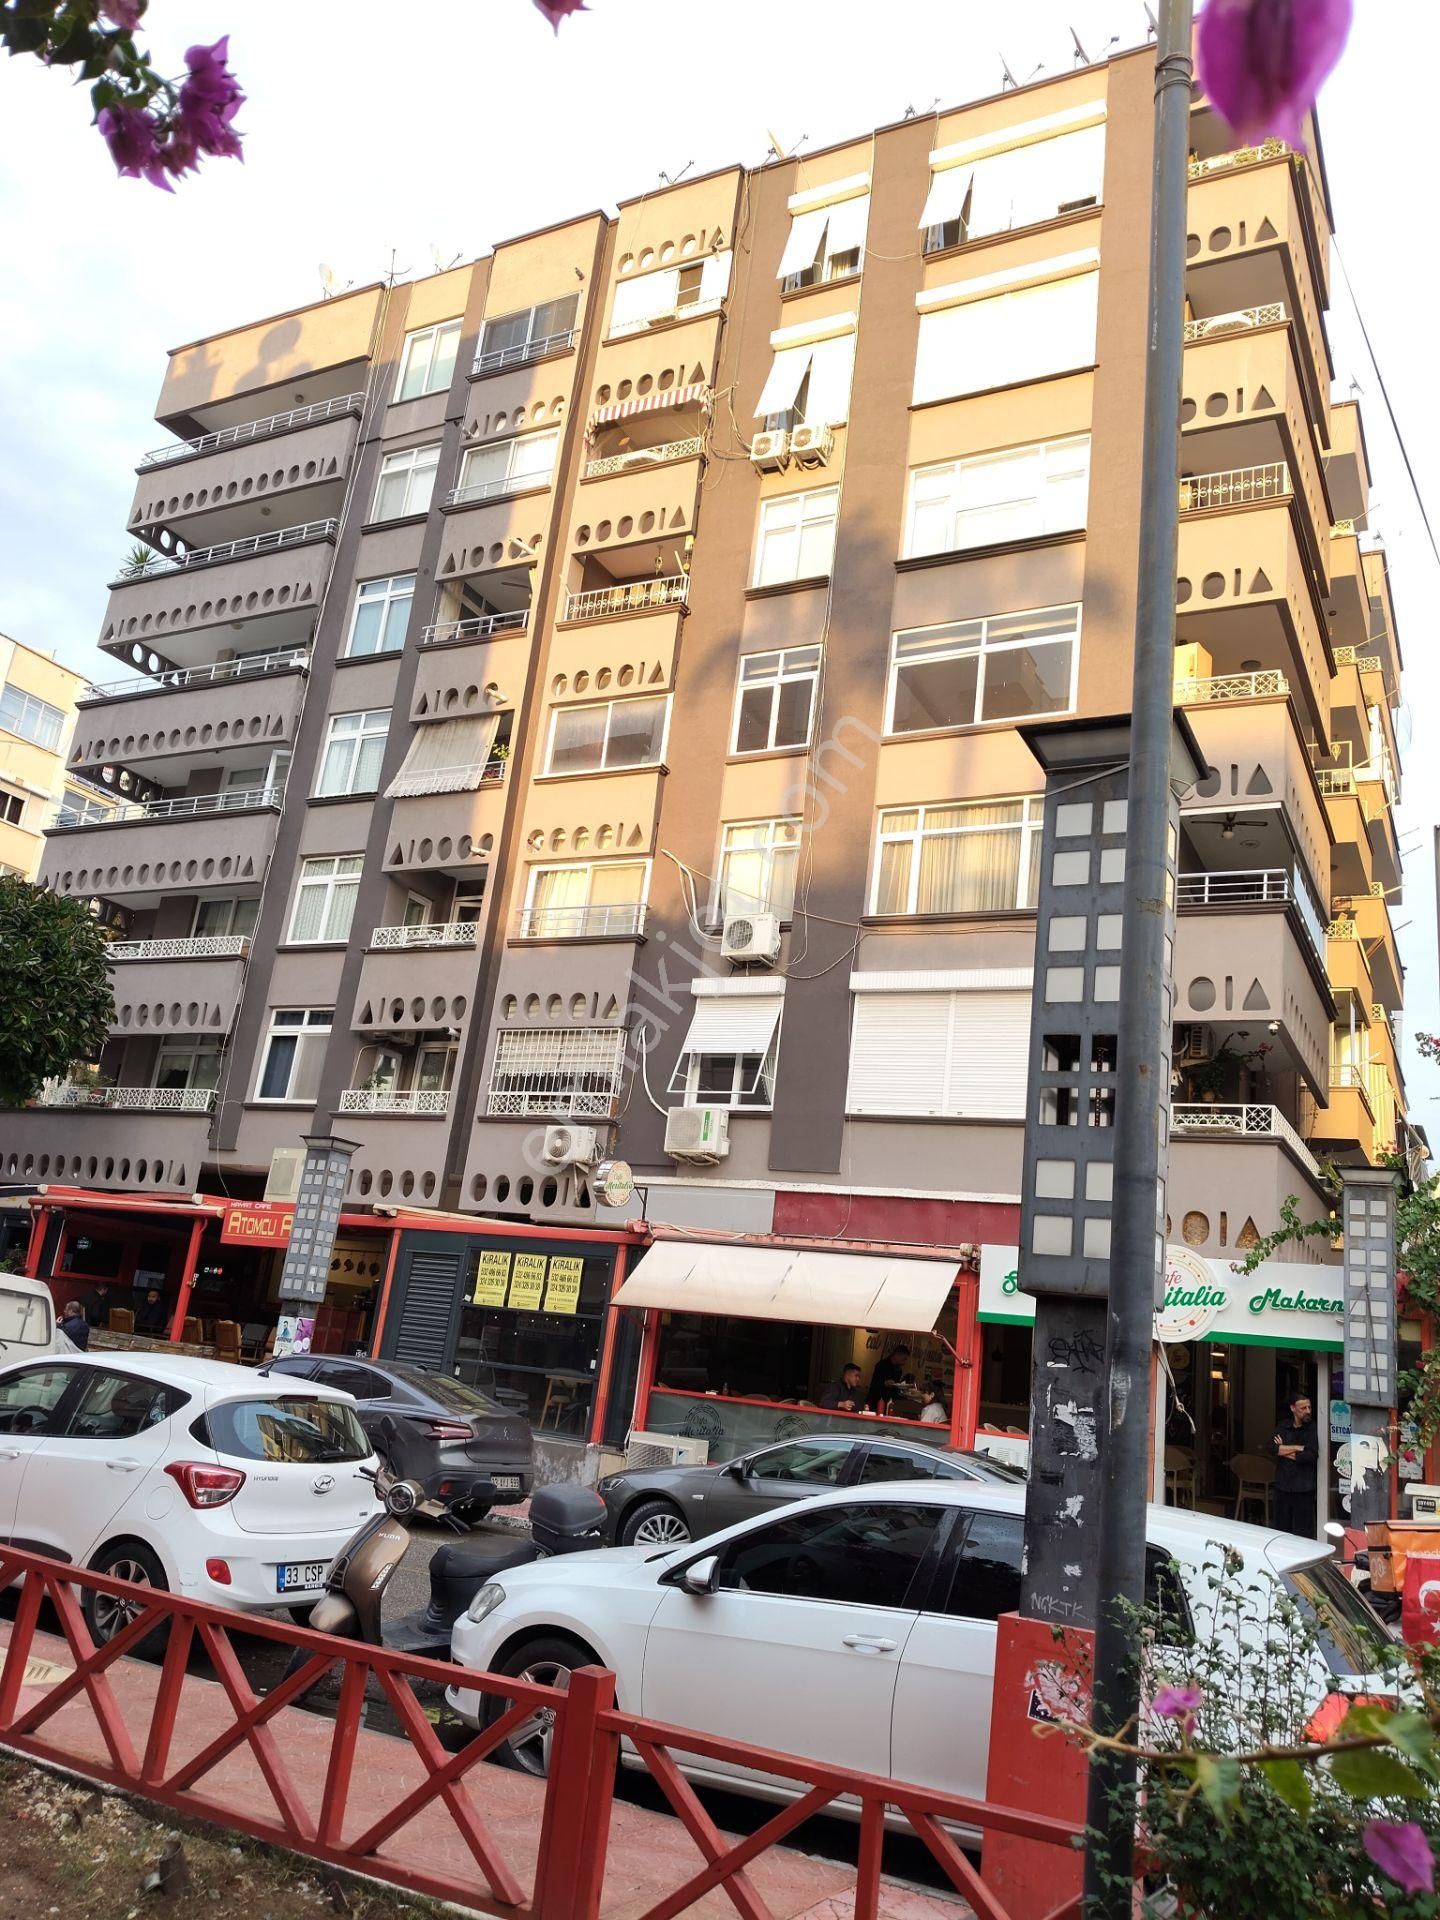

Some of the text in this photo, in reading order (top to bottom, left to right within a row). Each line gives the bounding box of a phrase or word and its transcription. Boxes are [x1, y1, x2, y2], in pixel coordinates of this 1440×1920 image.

[230, 1201, 273, 1210] HAYAT CAFE
[227, 1211, 278, 1236] ATOMCU
[1249, 1287, 1345, 1312] Makarn
[1331, 1425, 1352, 1434] SETCA
[286, 1565, 323, 1584] 33 CSP
